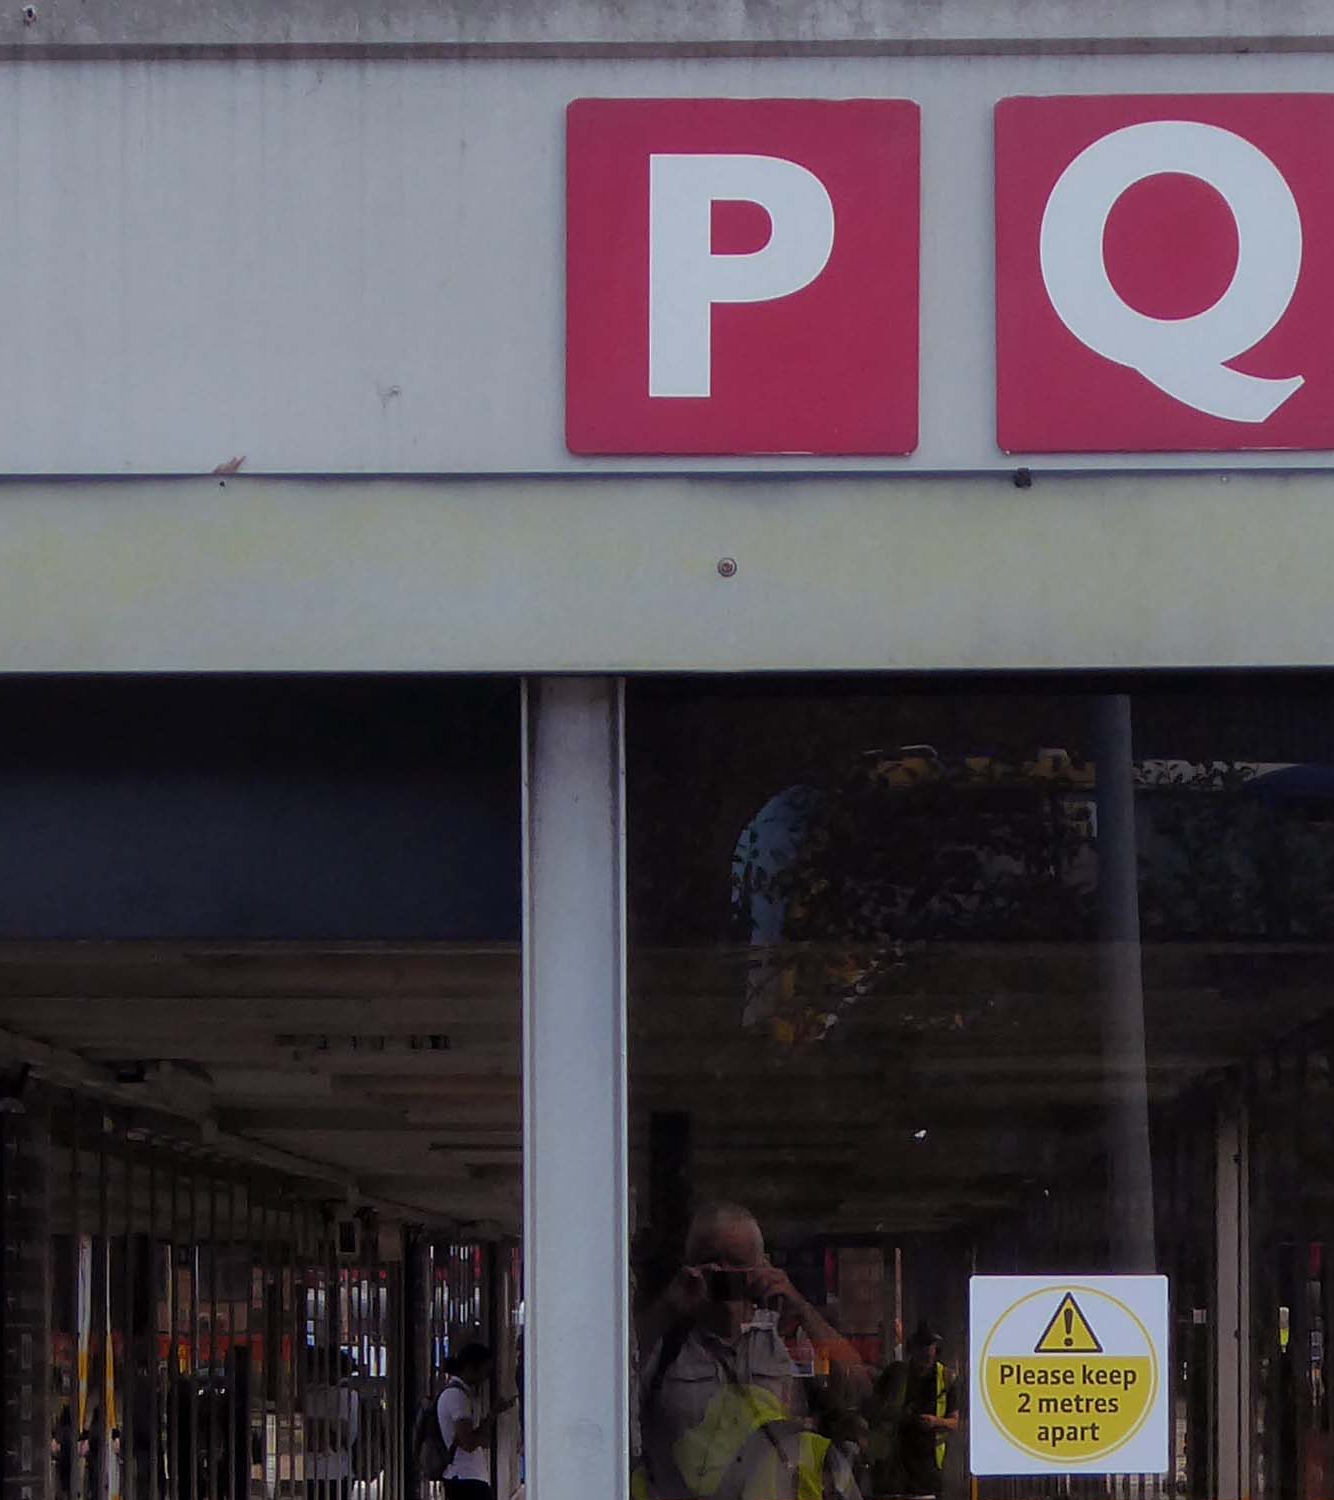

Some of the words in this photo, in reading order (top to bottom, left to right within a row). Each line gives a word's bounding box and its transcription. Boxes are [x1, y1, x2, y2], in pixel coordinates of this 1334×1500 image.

[648, 153, 836, 397] P
[1039, 120, 1306, 423] Q
[999, 1364, 1075, 1385] Please
[1082, 1364, 1137, 1391] keep
[1017, 1393, 1031, 1414] 2
[1038, 1394, 1119, 1414] metres
[1037, 1422, 1100, 1447] apart
